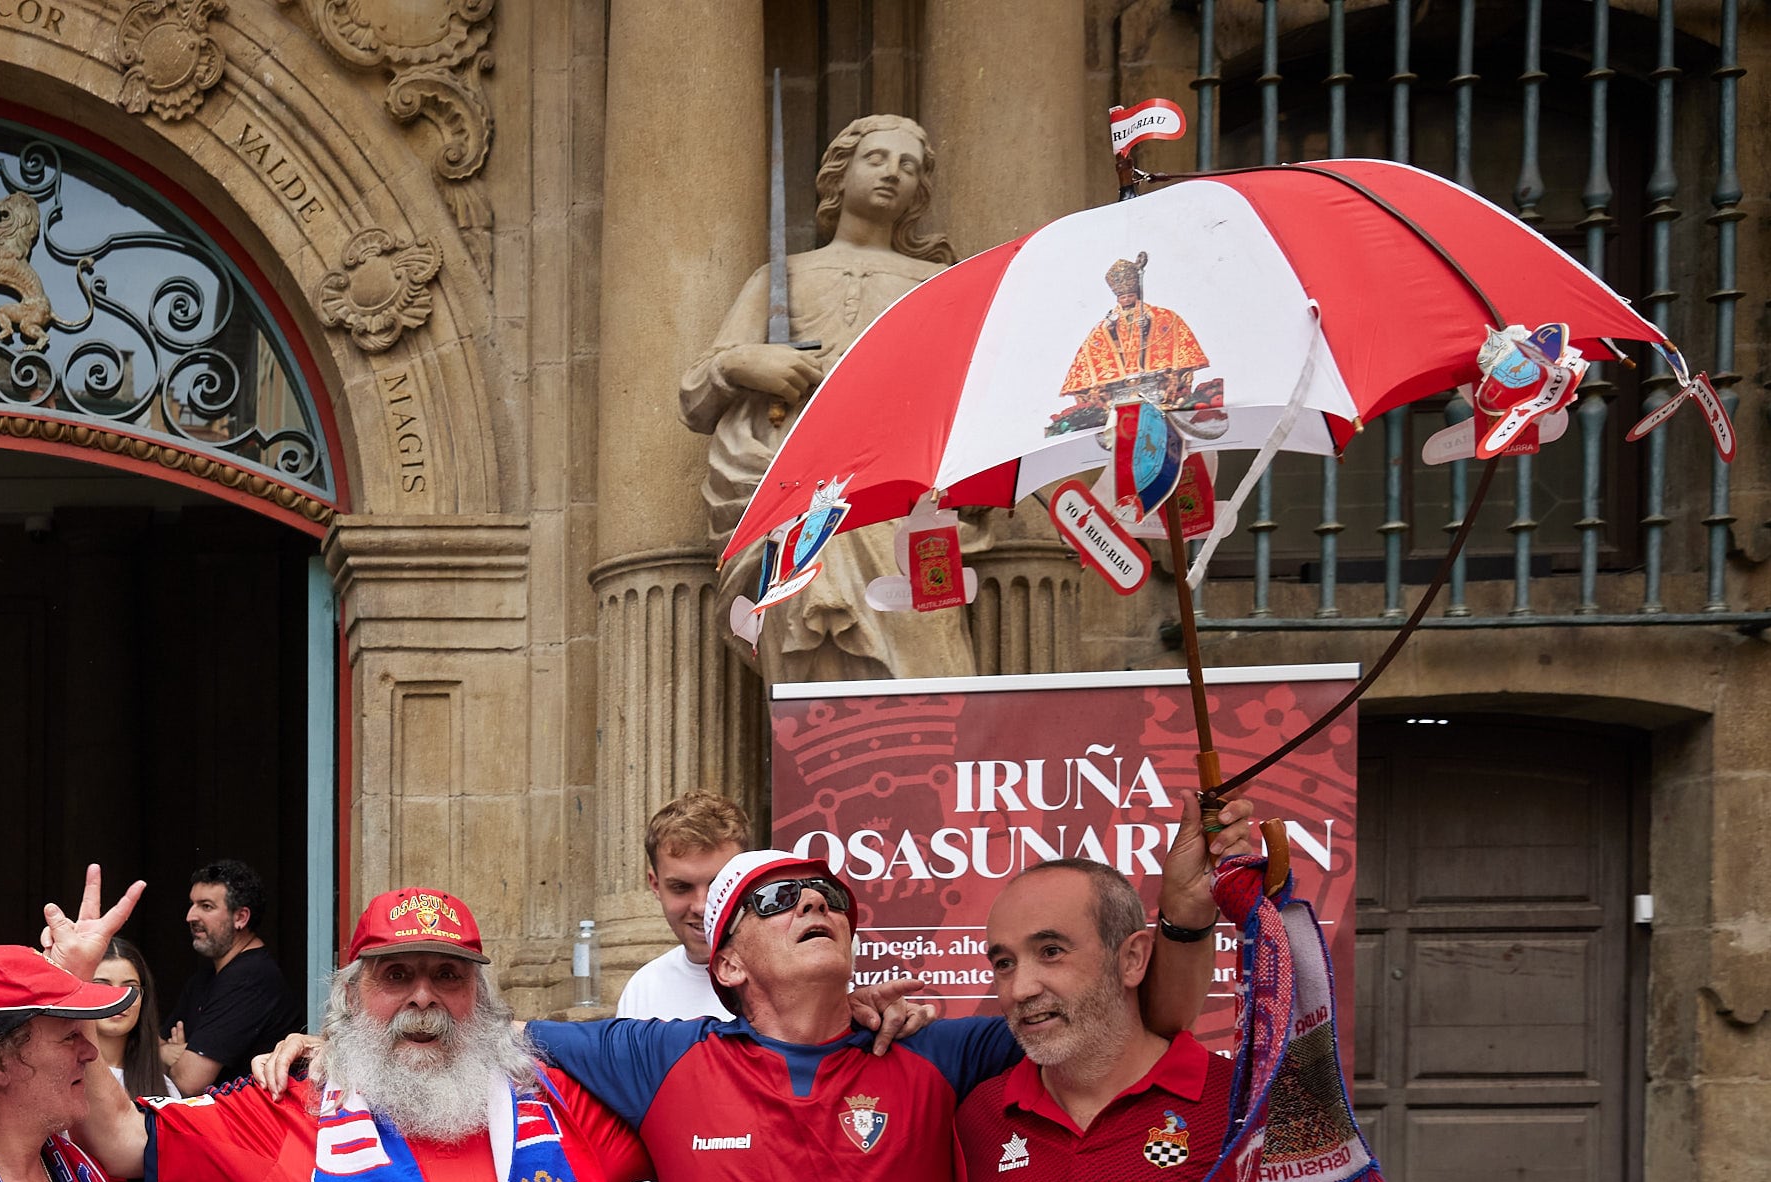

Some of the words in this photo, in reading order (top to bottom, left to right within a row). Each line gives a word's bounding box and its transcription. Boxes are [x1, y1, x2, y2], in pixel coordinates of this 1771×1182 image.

[238, 123, 324, 223] VALDE
[384, 373, 426, 493] MAGIS
[1065, 502, 1078, 518] YO
[1085, 525, 1132, 576] RIAU-RIAU
[954, 744, 1173, 812] IRUÑA
[792, 820, 1334, 881] OSASUNARN
[390, 893, 461, 927] OSASUNA
[395, 929, 418, 937] CLUB
[420, 929, 462, 940] ATLETICO
[692, 1134, 752, 1150] hummel
